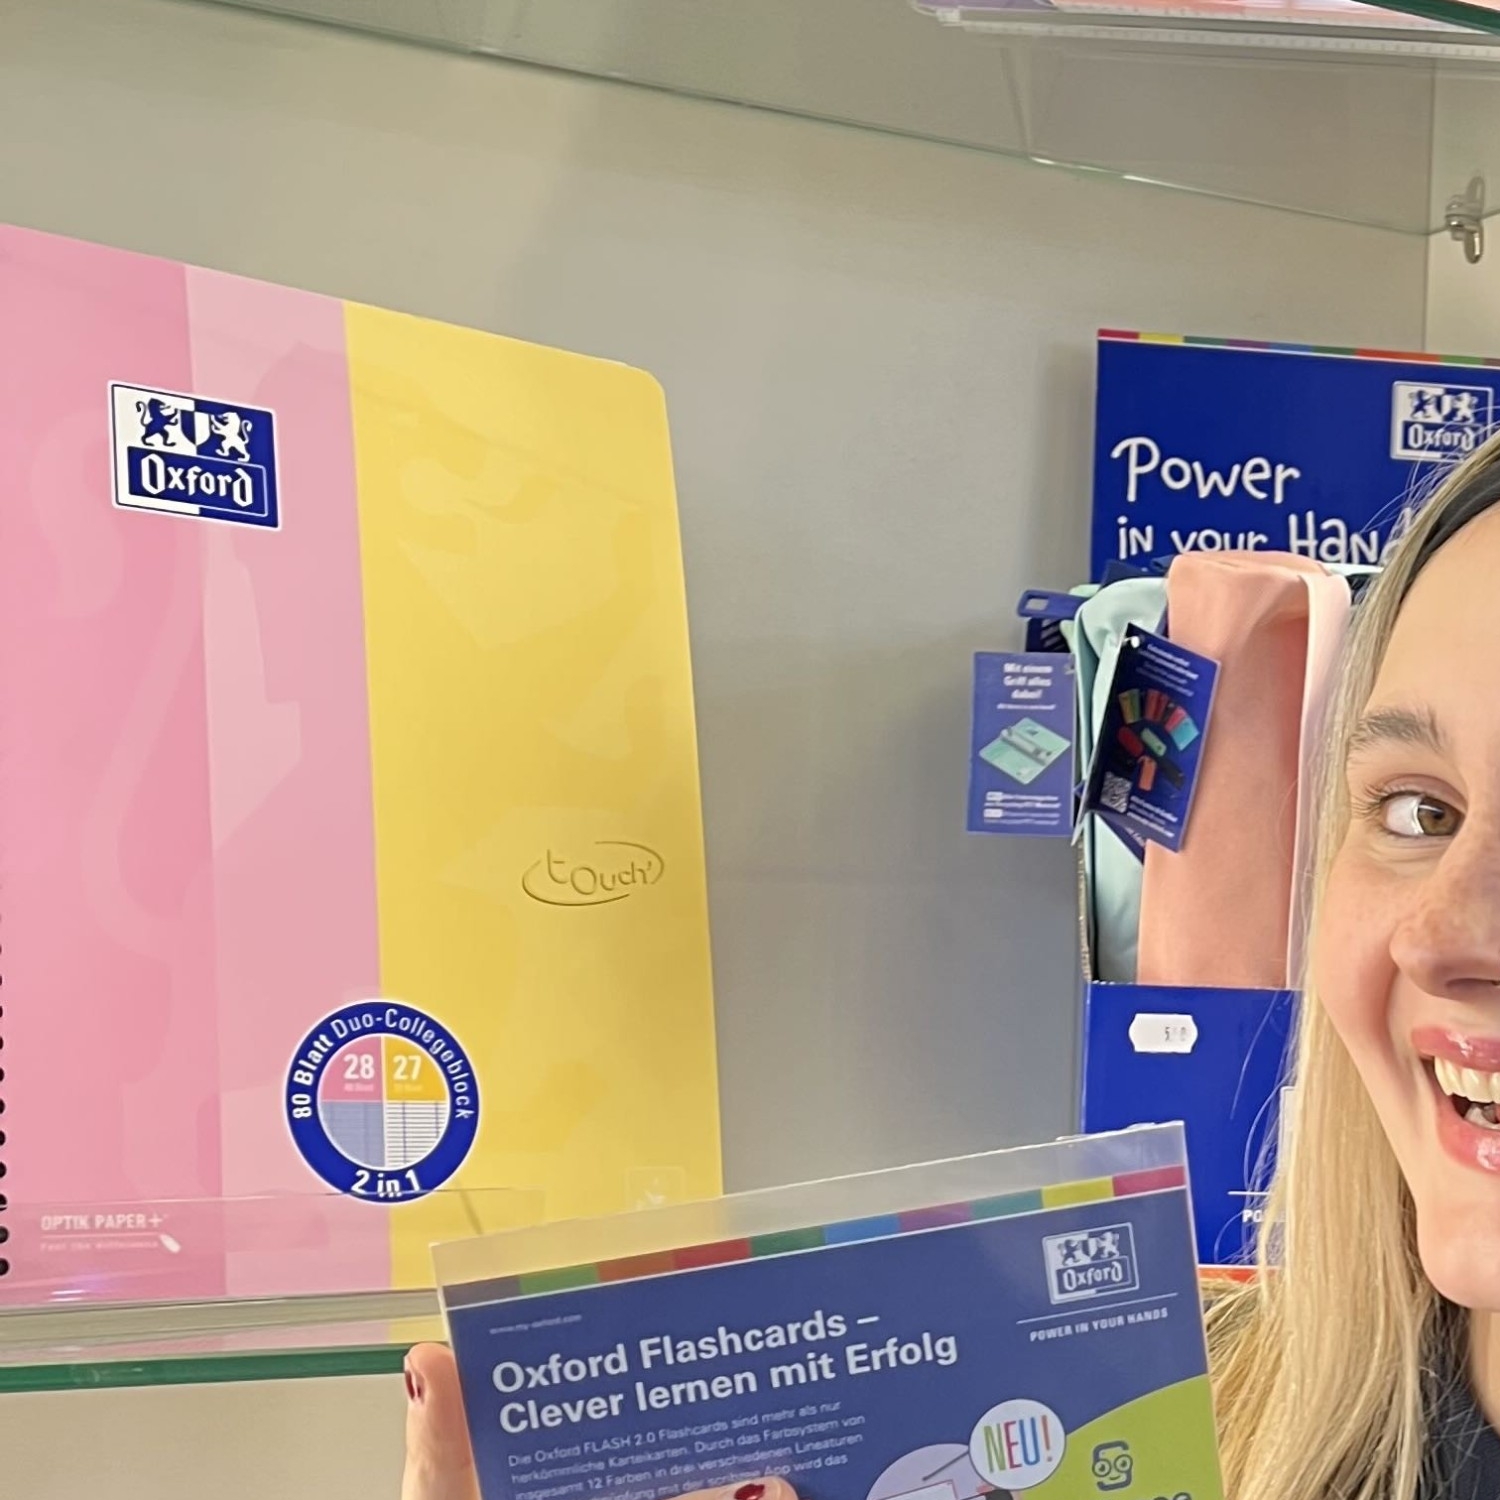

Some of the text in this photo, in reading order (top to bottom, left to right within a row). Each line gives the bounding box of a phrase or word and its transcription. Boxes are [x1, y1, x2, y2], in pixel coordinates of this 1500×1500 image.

[1408, 424, 1476, 451] Oxford
[141, 453, 252, 507] Oxford
[1111, 436, 1300, 504] Power
[291, 1009, 474, 1119] 80 Blatt Duo-Collegeblock
[344, 1054, 375, 1079] 28
[393, 1056, 421, 1080] 27
[351, 1169, 421, 1195] 2 in 1
[40, 1215, 90, 1231] OPTIK
[1063, 1261, 1123, 1291] Oxford
[1030, 1307, 1168, 1342] POWER IN YOUR HANDS
[491, 1344, 628, 1393] Oxford
[639, 1309, 848, 1369] Flashcards
[499, 1331, 958, 1433] Clever lernen mit Erfolg
[534, 1445, 581, 1463] Oxford
[584, 1435, 631, 1454] FLASH
[634, 1432, 656, 1447] 2.0
[659, 1421, 728, 1440] Flashcards
[731, 1414, 758, 1430] sind
[762, 1407, 796, 1423] mehr
[694, 1437, 735, 1453] Durch
[736, 1431, 761, 1446] das
[763, 1418, 839, 1442] Farbsystem
[842, 1415, 866, 1428] von
[983, 1414, 1053, 1474] NEU!
[587, 1477, 603, 1490] 12
[606, 1469, 651, 1487] Farben
[655, 1467, 667, 1478] in
[795, 1433, 864, 1454] Lineaturen
[793, 1456, 822, 1472] wird
[824, 1454, 849, 1467] das
